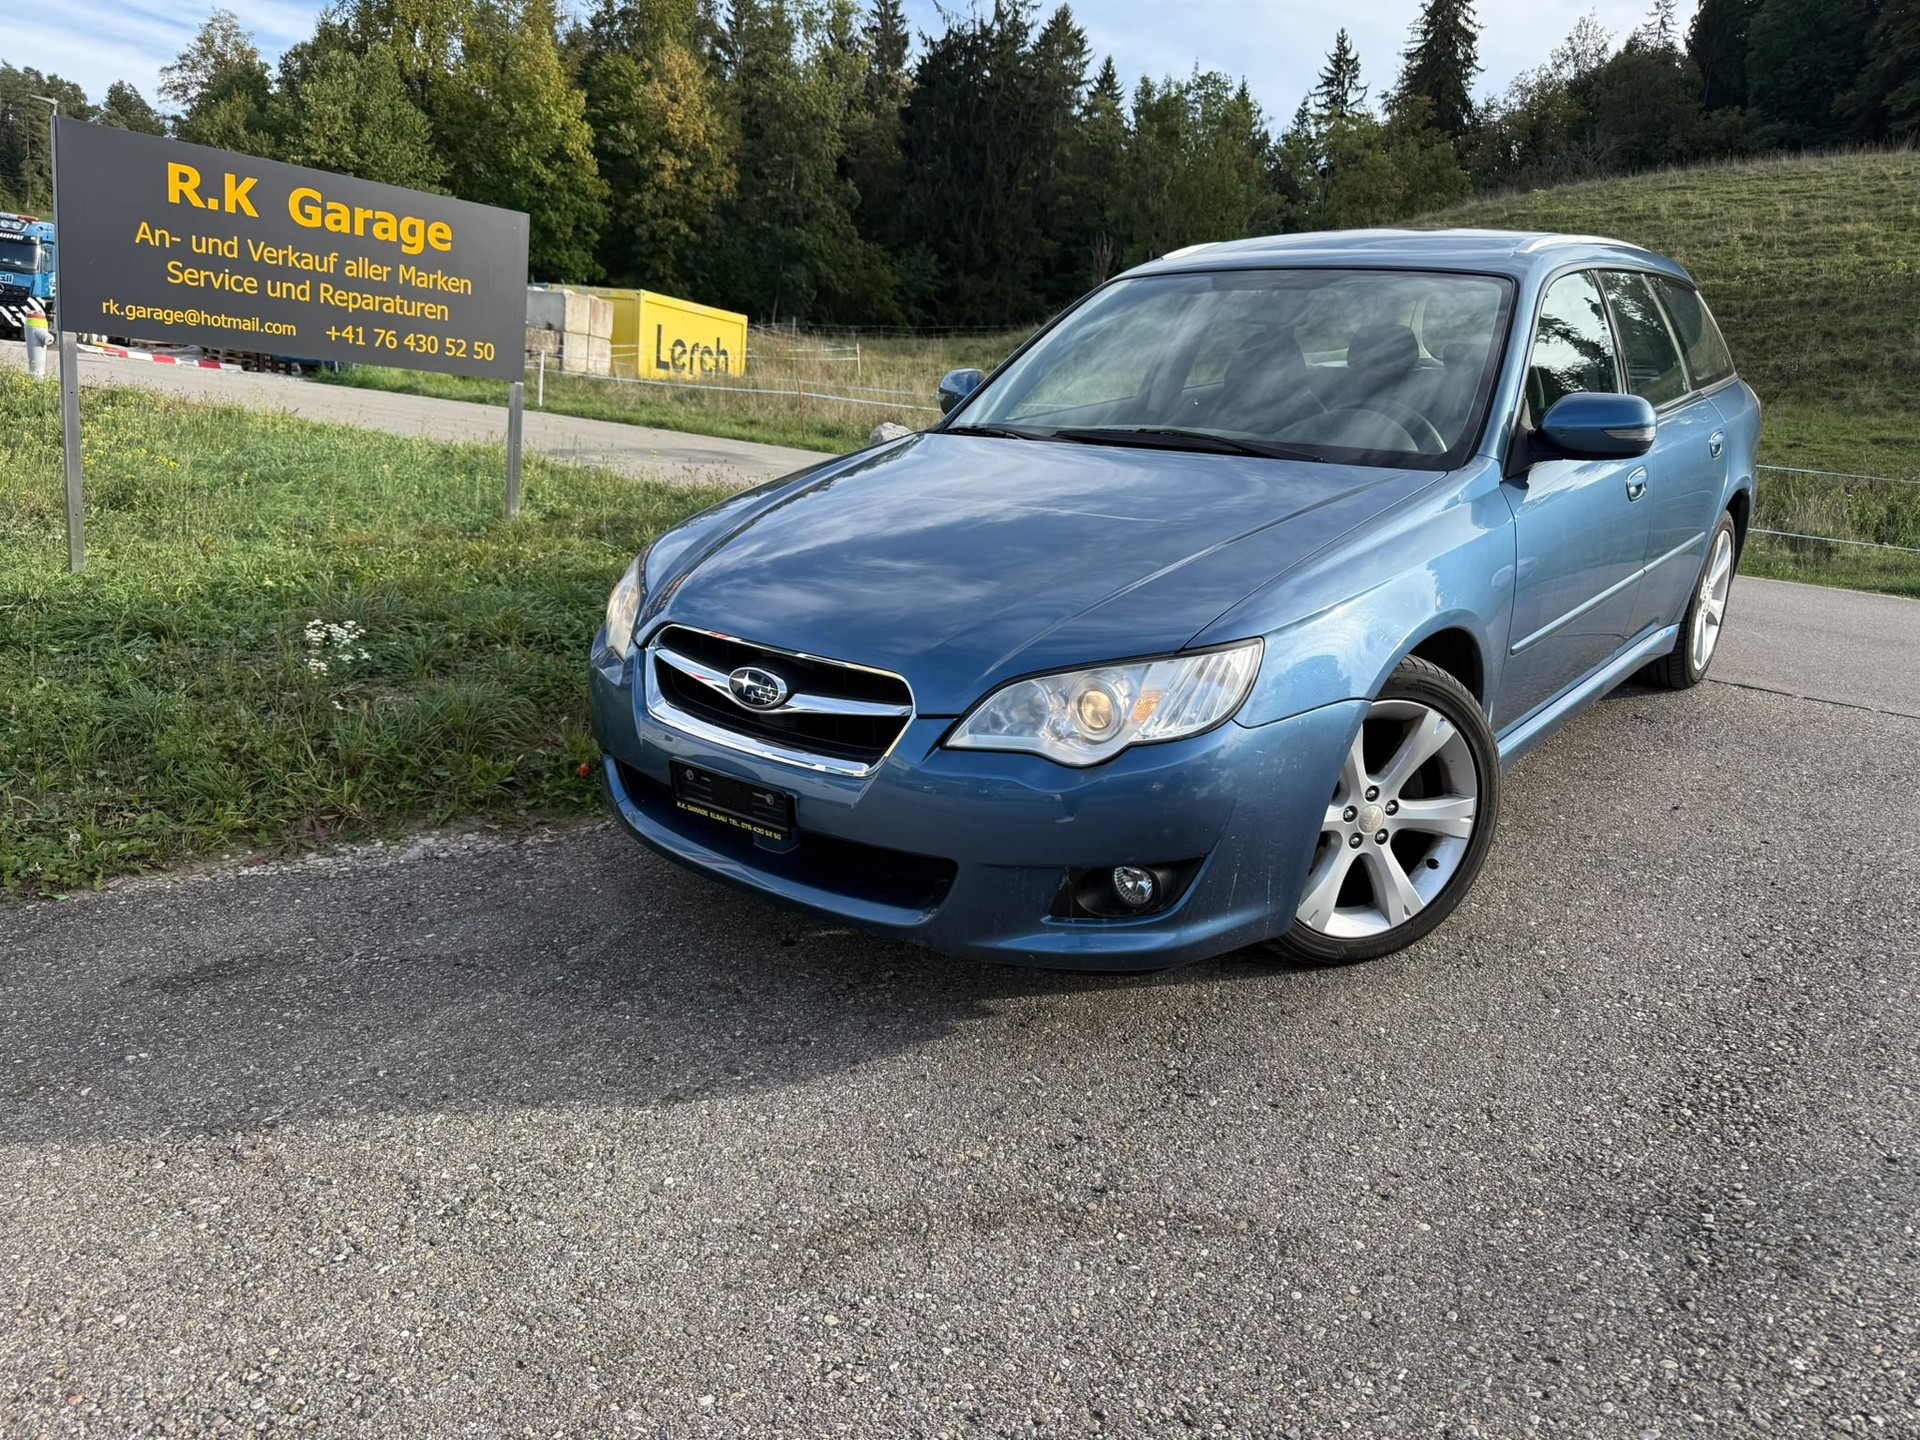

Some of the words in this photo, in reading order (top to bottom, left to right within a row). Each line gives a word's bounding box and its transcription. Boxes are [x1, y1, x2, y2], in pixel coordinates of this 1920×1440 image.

[167, 162, 259, 219] R.K
[287, 187, 453, 256] Garage
[135, 222, 182, 249] An-
[191, 236, 239, 260] und
[248, 240, 339, 275] Verkauf
[344, 257, 392, 283] aller
[398, 265, 473, 295] Marken
[166, 261, 259, 295] Service
[266, 280, 311, 303] und
[319, 283, 450, 322] Reparaturen
[101, 300, 298, 338] rk.garage@hotmail.com
[326, 324, 366, 347] +41
[374, 328, 399, 350] 76
[403, 333, 441, 356] 430
[445, 337, 468, 359] 52
[473, 340, 497, 363] 50
[656, 324, 728, 374] Lerch
[687, 804, 708, 816] GARAGE
